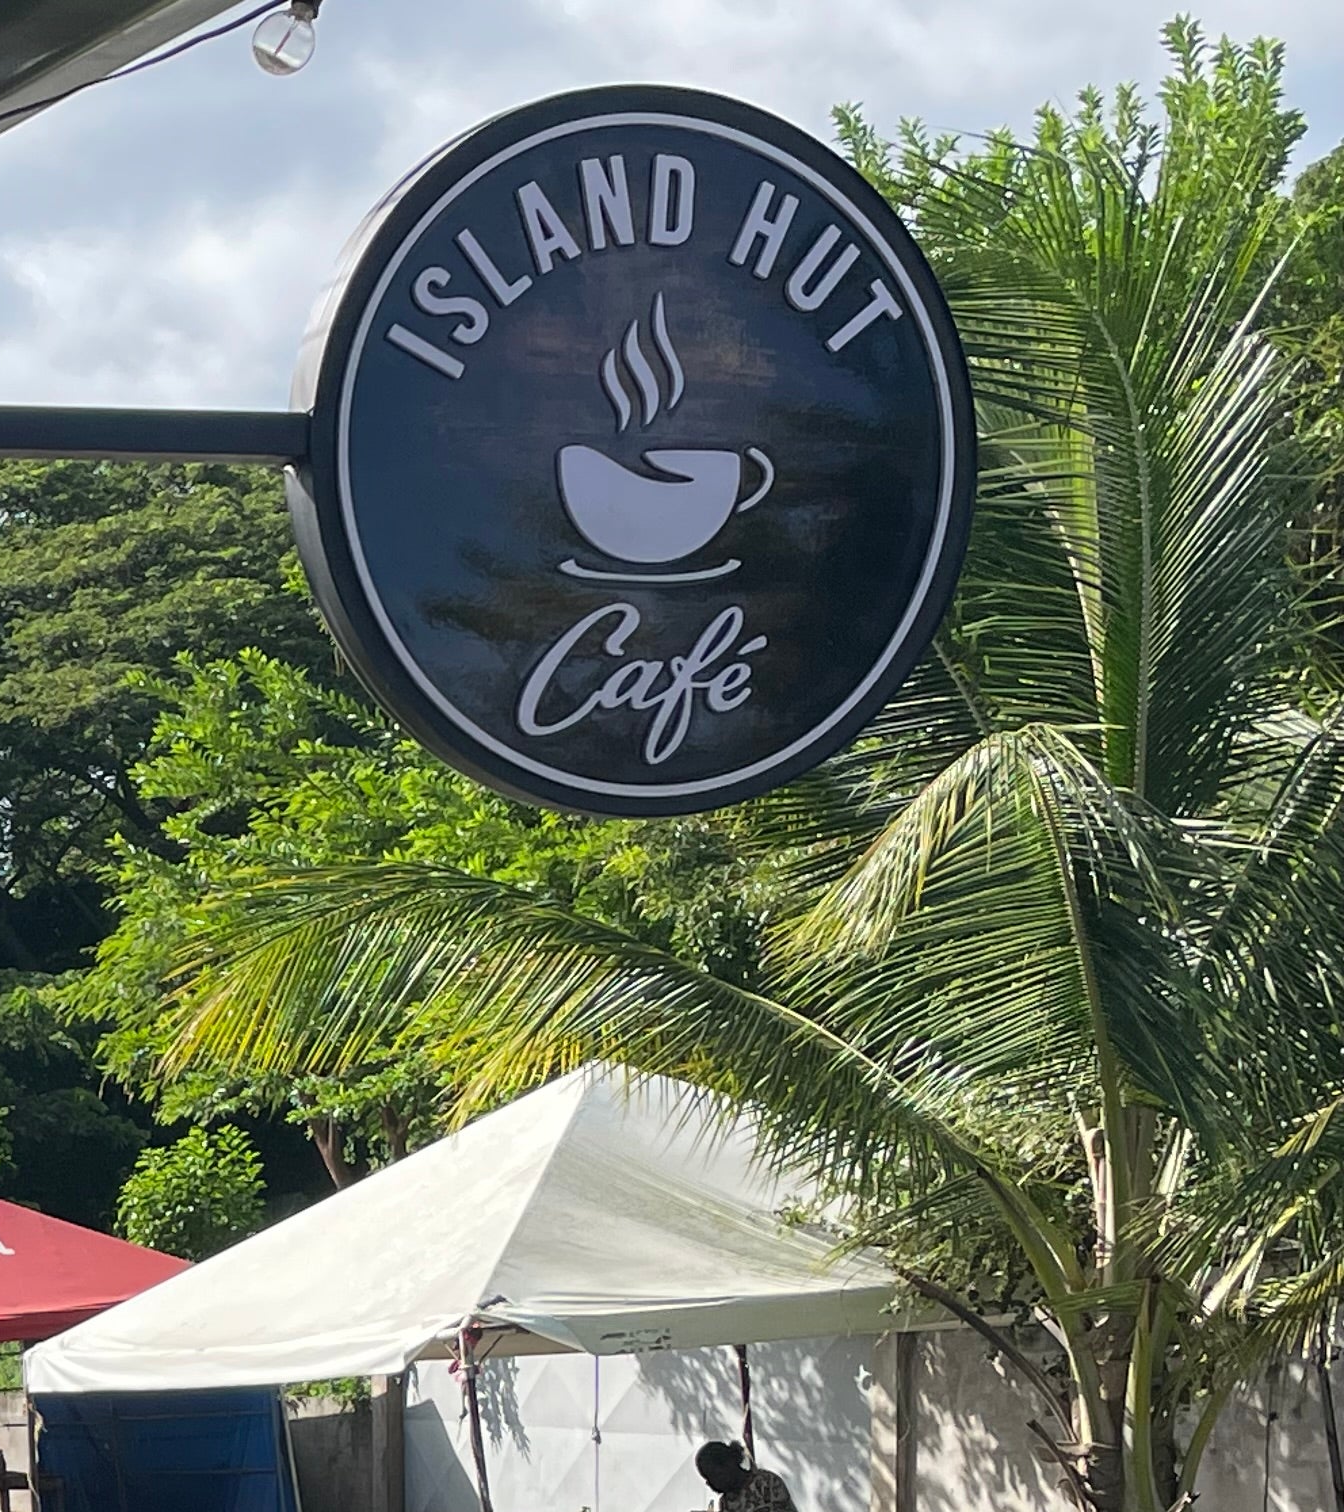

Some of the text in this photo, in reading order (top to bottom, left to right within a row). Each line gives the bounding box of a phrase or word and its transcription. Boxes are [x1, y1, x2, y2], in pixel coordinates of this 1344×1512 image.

[386, 152, 904, 379] ISLAND HUT
[517, 602, 768, 764] Café
